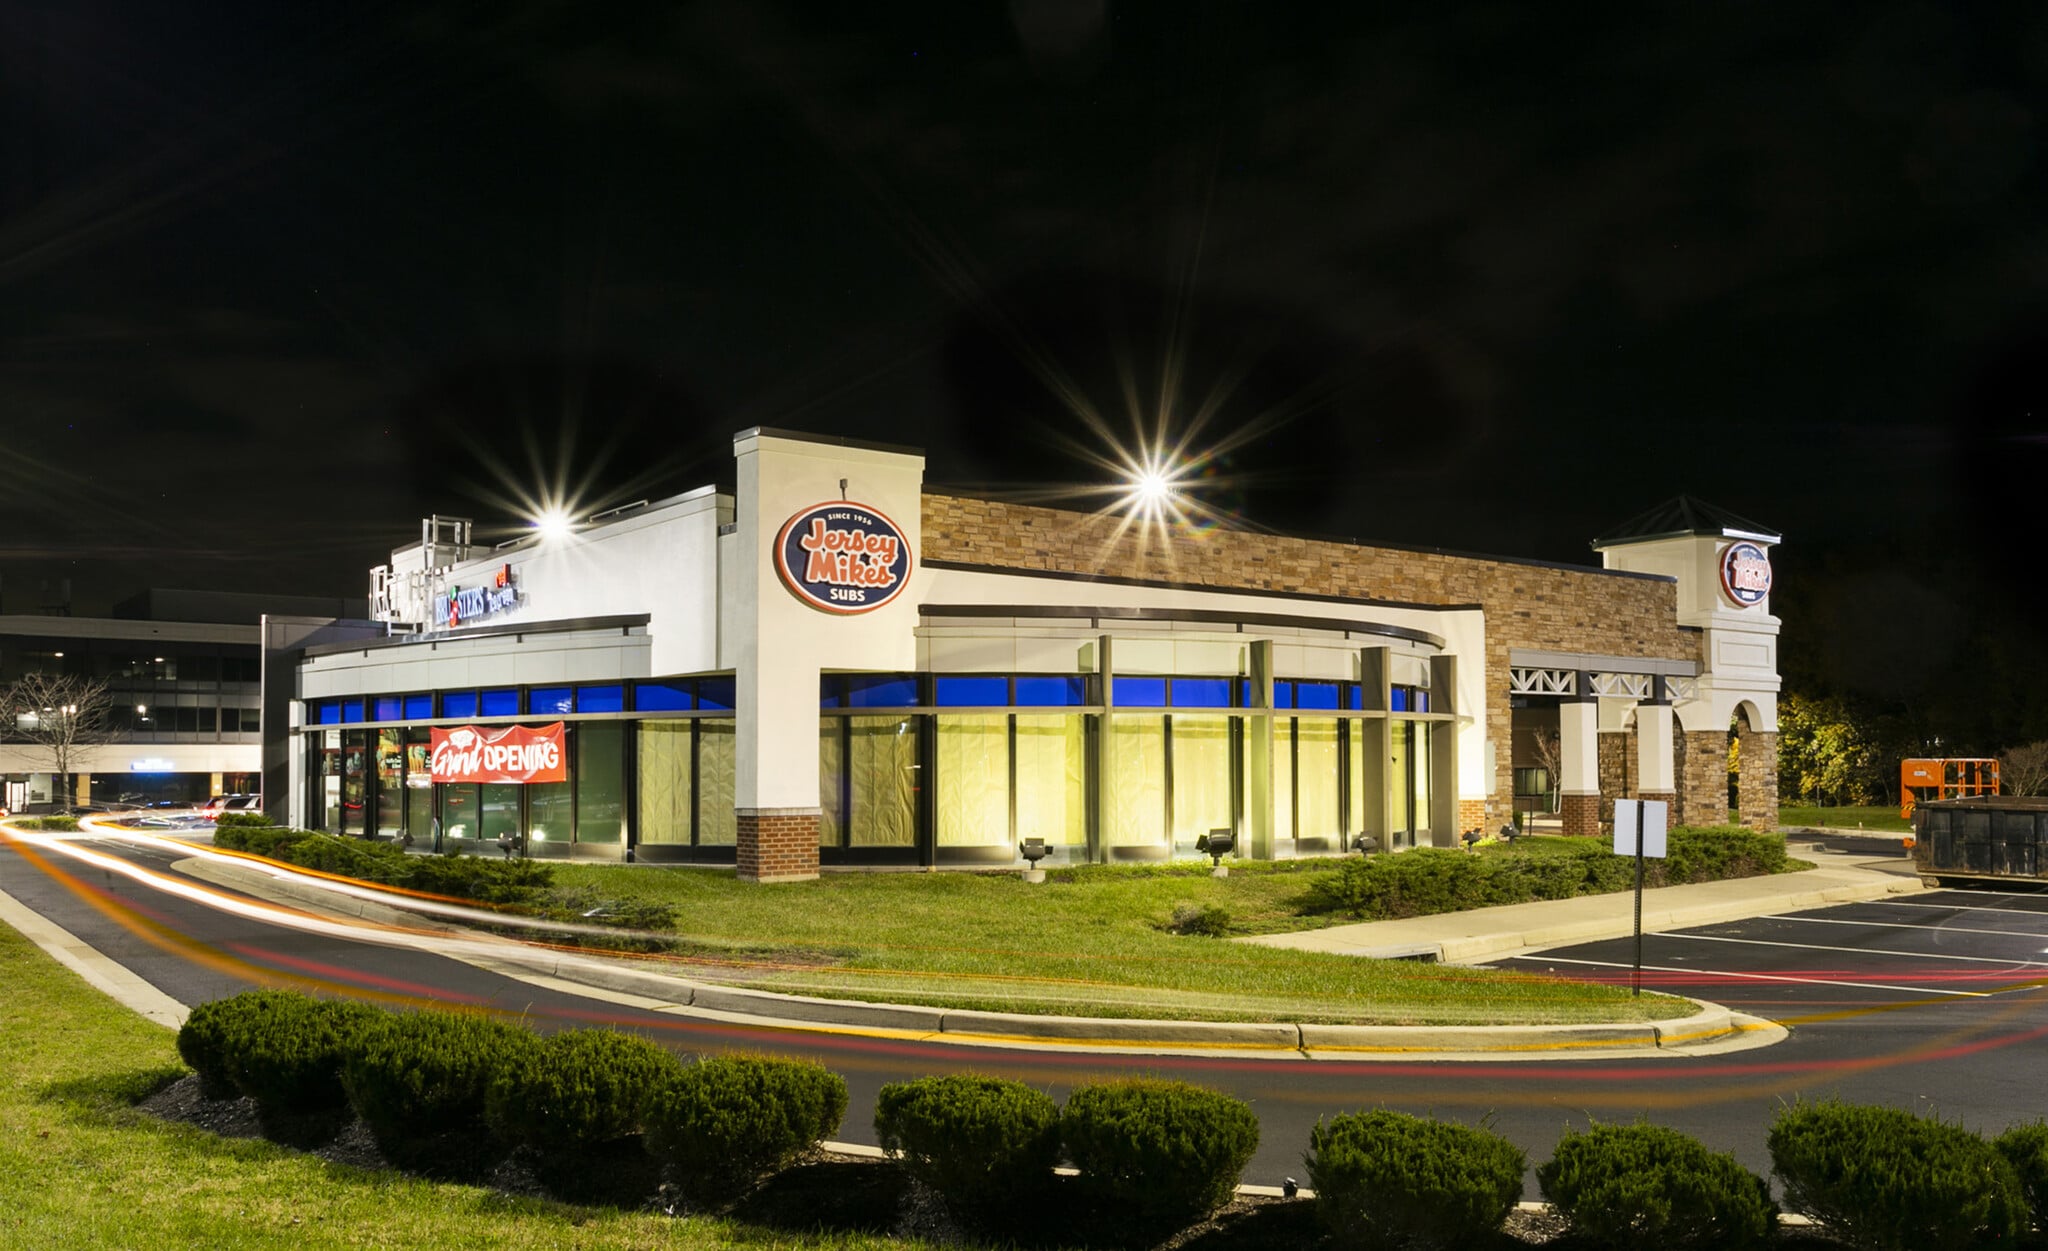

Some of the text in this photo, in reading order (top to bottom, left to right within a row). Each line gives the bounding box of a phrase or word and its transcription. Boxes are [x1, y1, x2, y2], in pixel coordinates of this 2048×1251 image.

[854, 514, 872, 526] 1956
[801, 518, 899, 565] Jersey
[806, 551, 896, 588] Mike's
[830, 588, 865, 601] SUBS
[484, 742, 559, 771] OPENING
